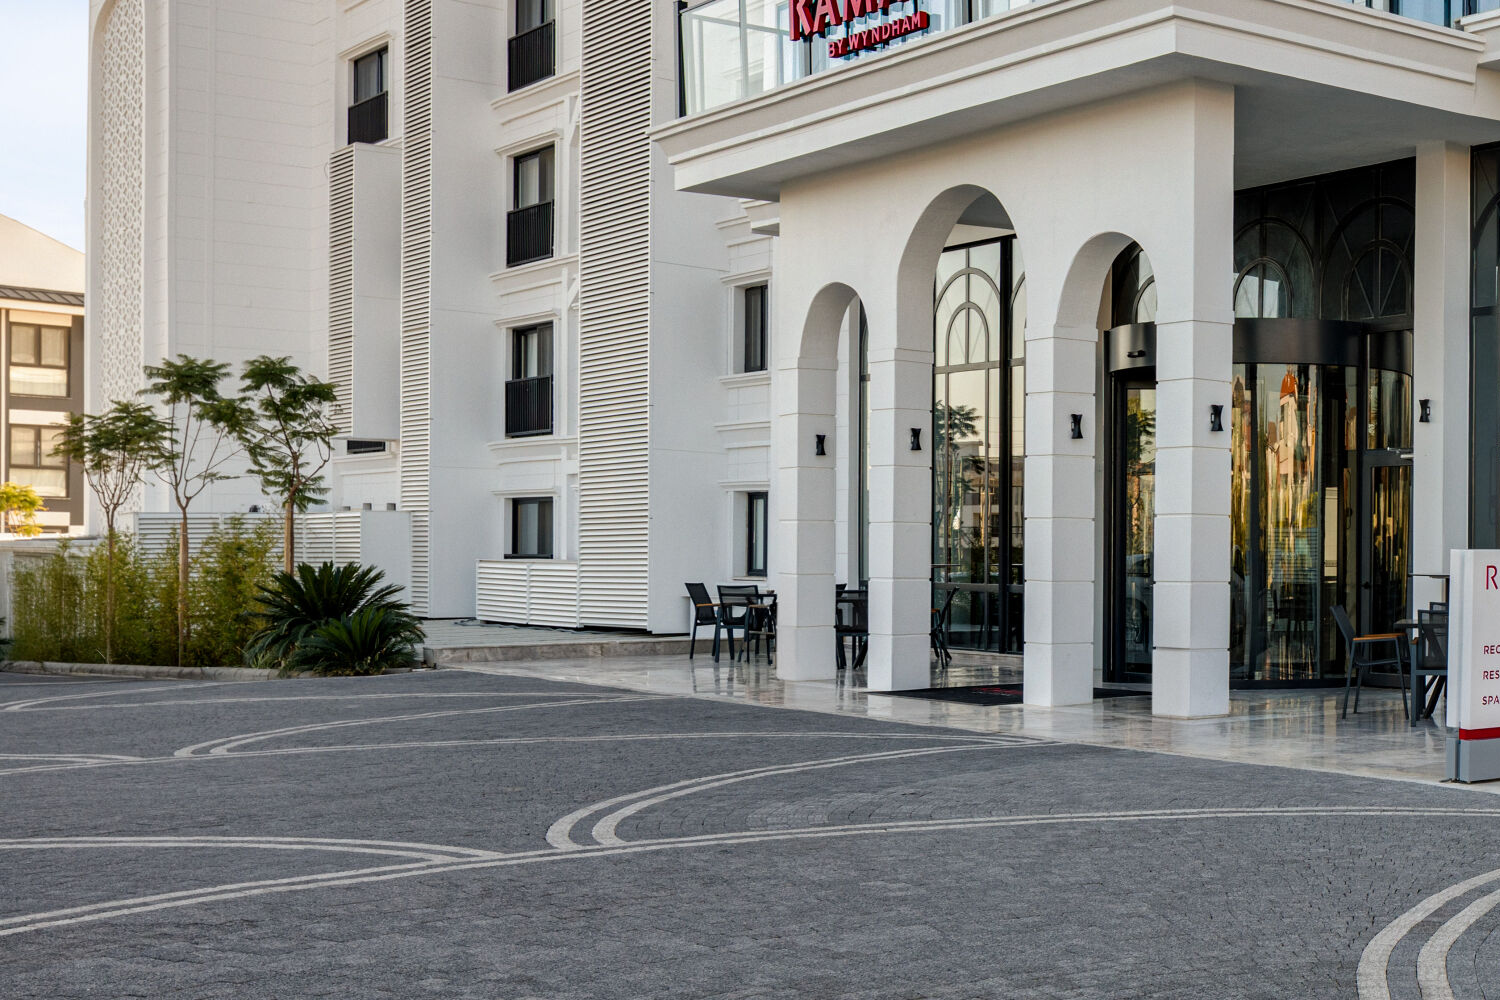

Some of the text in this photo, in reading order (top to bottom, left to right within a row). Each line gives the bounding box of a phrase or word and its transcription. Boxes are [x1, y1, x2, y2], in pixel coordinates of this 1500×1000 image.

[828, 12, 925, 58] BY WYNDHAM
[1482, 695, 1500, 706] SPA
